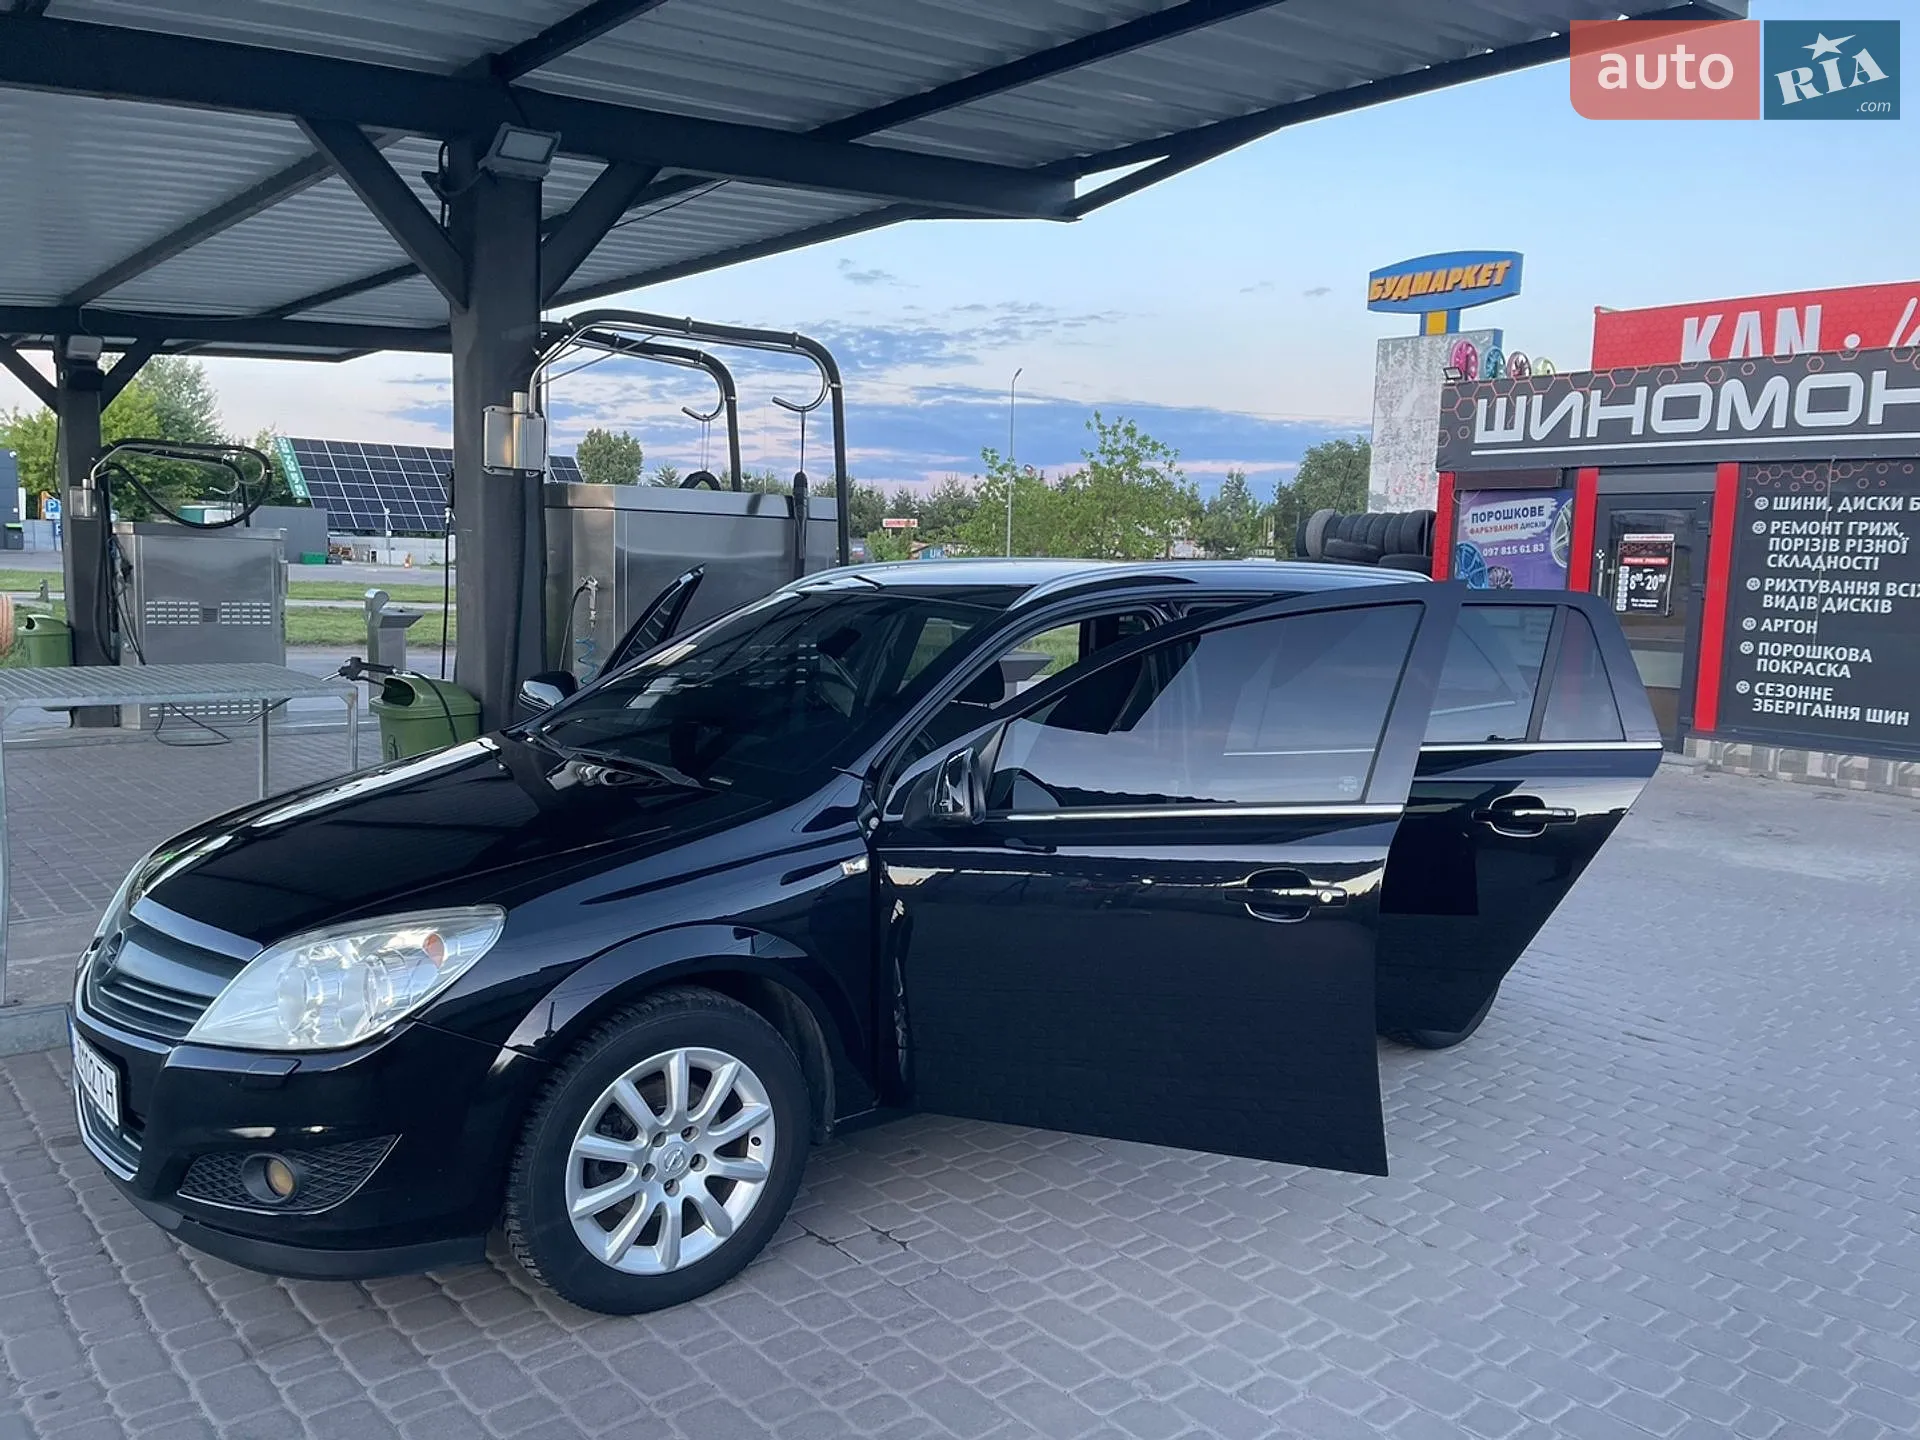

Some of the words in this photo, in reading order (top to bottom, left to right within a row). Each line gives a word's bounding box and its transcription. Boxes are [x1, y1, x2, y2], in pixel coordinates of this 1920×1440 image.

[1367, 260, 1513, 302] БУДМАРКЕТ
[1772, 496, 1833, 512] ШИНИ,
[1837, 496, 1904, 513] ДИСКИ
[1471, 505, 1545, 524] ПОРОШКОВЕ
[1770, 520, 1844, 535] РЕМОНТ
[1847, 521, 1905, 538] ГРИЖ,
[1768, 537, 1840, 553] ПОРІЗІВ
[1845, 537, 1910, 555] РІЗНОЇ
[1766, 554, 1880, 571] СКЛАДНОСТІ
[1764, 577, 1880, 596] РИХТУВАННЯ
[1762, 594, 1818, 612] ВИДІВ
[1821, 597, 1893, 614] ДИСКІВ
[1760, 618, 1818, 634] АРГОН
[1758, 642, 1873, 663] ПОРОШКОВА
[1756, 658, 1852, 679] ПОКРАСКА
[1754, 682, 1835, 701] СЕЗОННЕ
[1752, 697, 1861, 722] ЗБЕРІГАННЯ
[1865, 708, 1910, 726] ШИН
